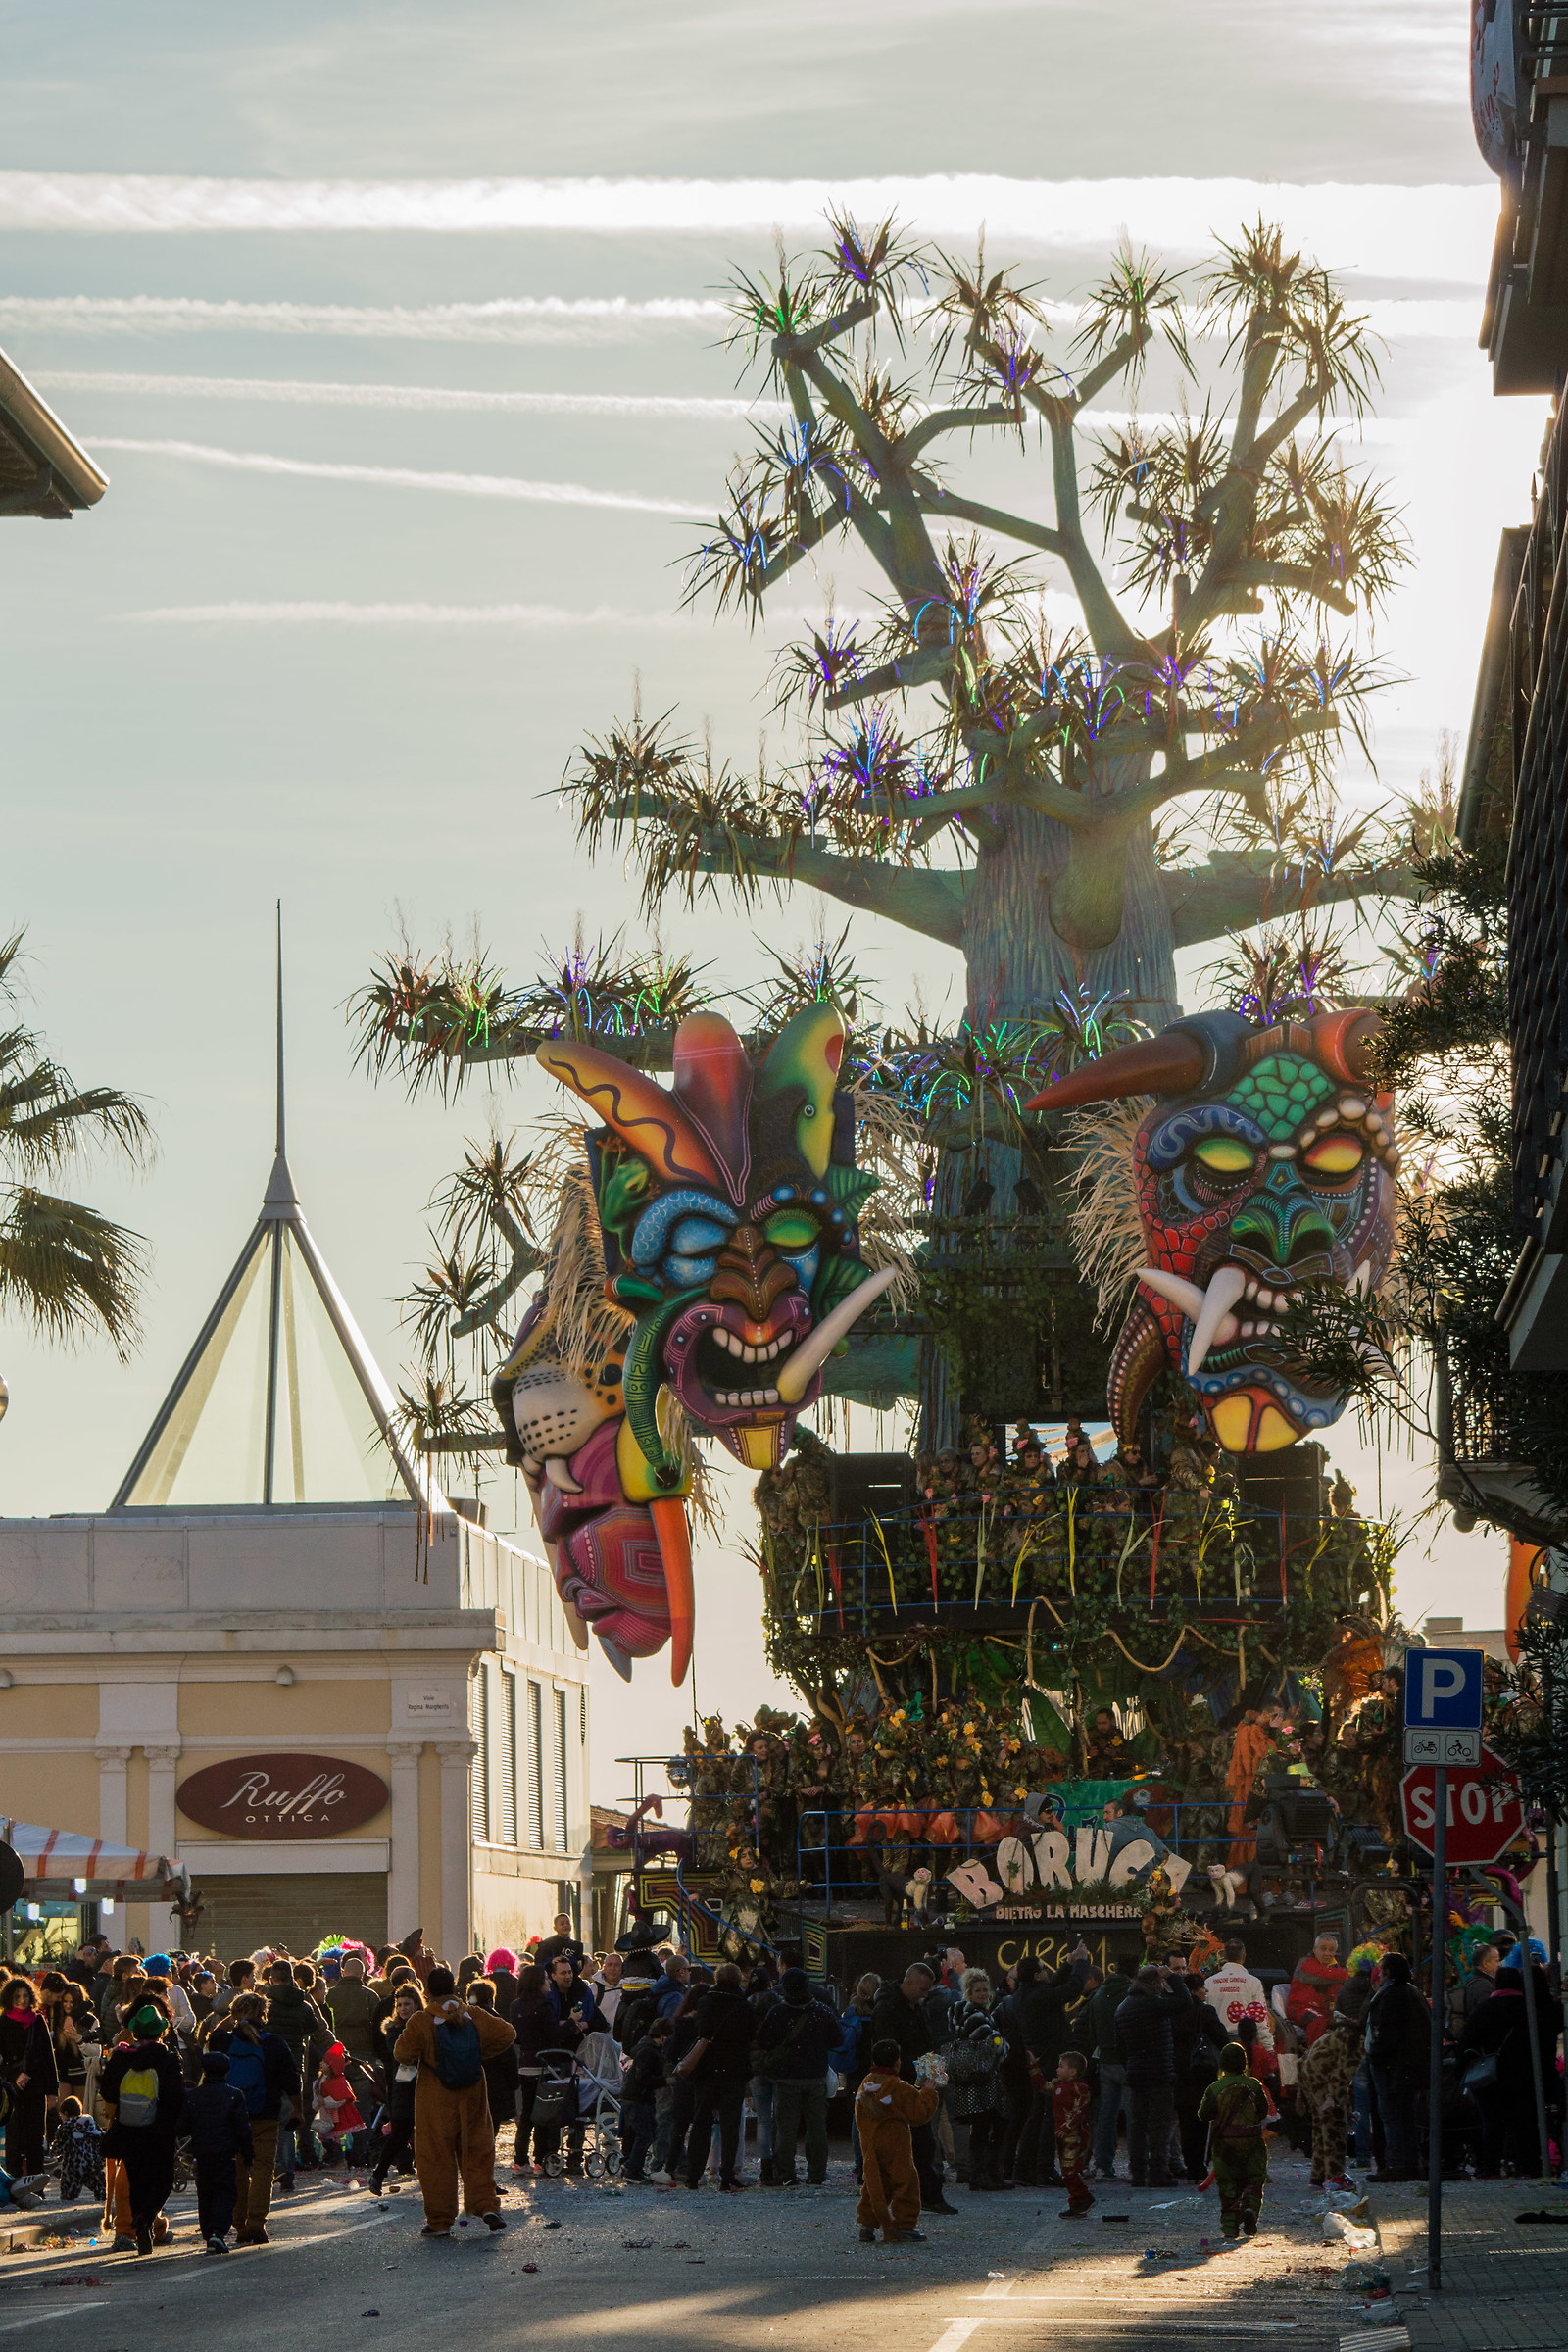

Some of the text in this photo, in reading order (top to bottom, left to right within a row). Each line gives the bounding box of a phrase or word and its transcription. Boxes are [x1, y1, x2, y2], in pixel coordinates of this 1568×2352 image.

[1421, 1658, 1466, 1718] P
[219, 1771, 347, 1815] Ruffo
[245, 1814, 330, 1823] OTTICA
[1046, 1904, 1065, 1919] LA
[1069, 1904, 1145, 1919] MASCHERA
